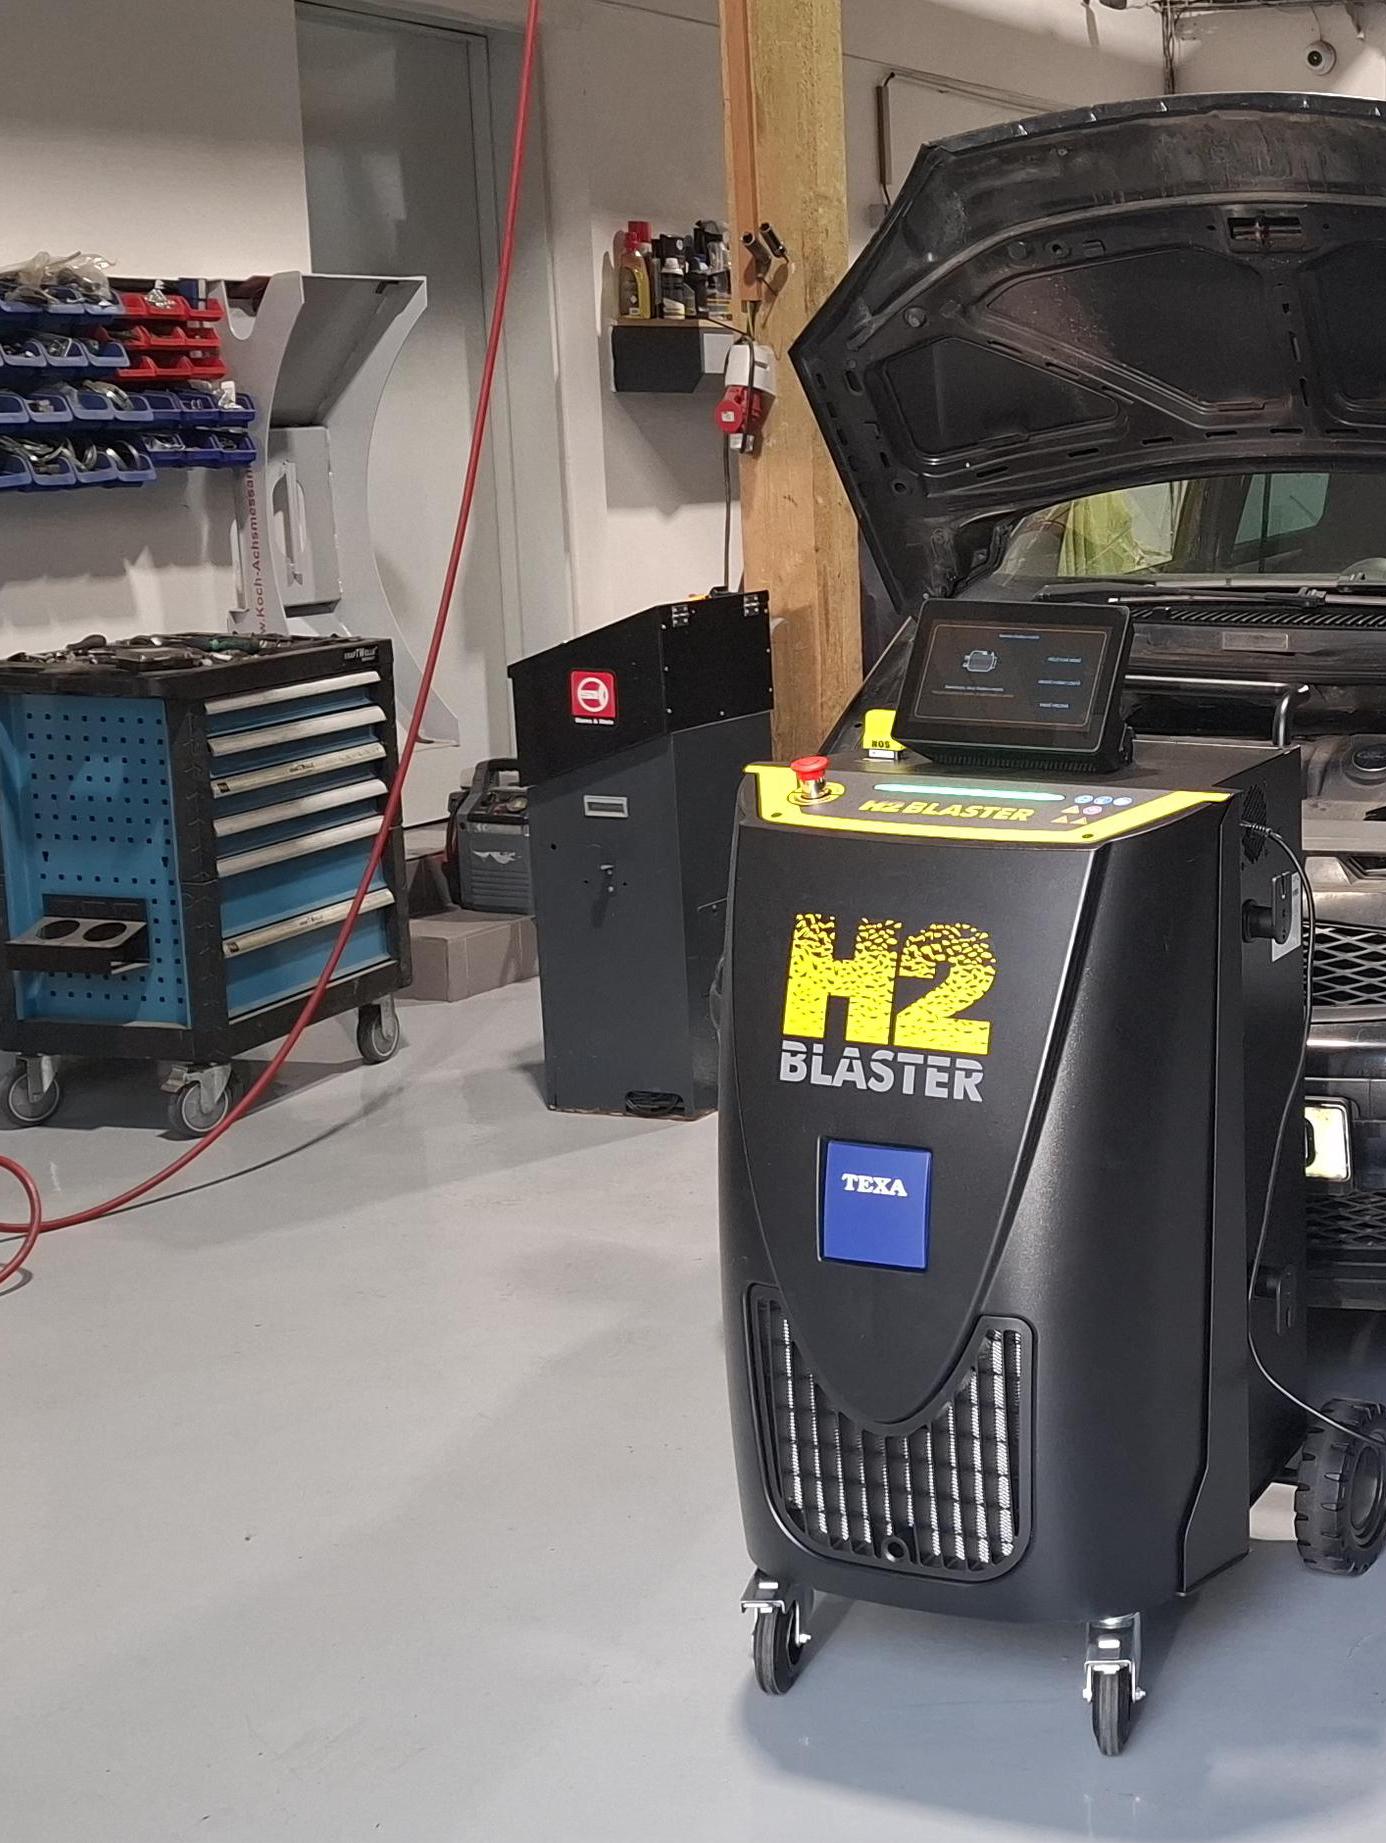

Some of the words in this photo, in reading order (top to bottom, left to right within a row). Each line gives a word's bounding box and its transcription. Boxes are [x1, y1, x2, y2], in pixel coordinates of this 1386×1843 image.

[901, 801, 1034, 822] BLASTER
[782, 913, 996, 1055] H2
[780, 1040, 983, 1102] BLASTER
[841, 1173, 908, 1197] TEXA
